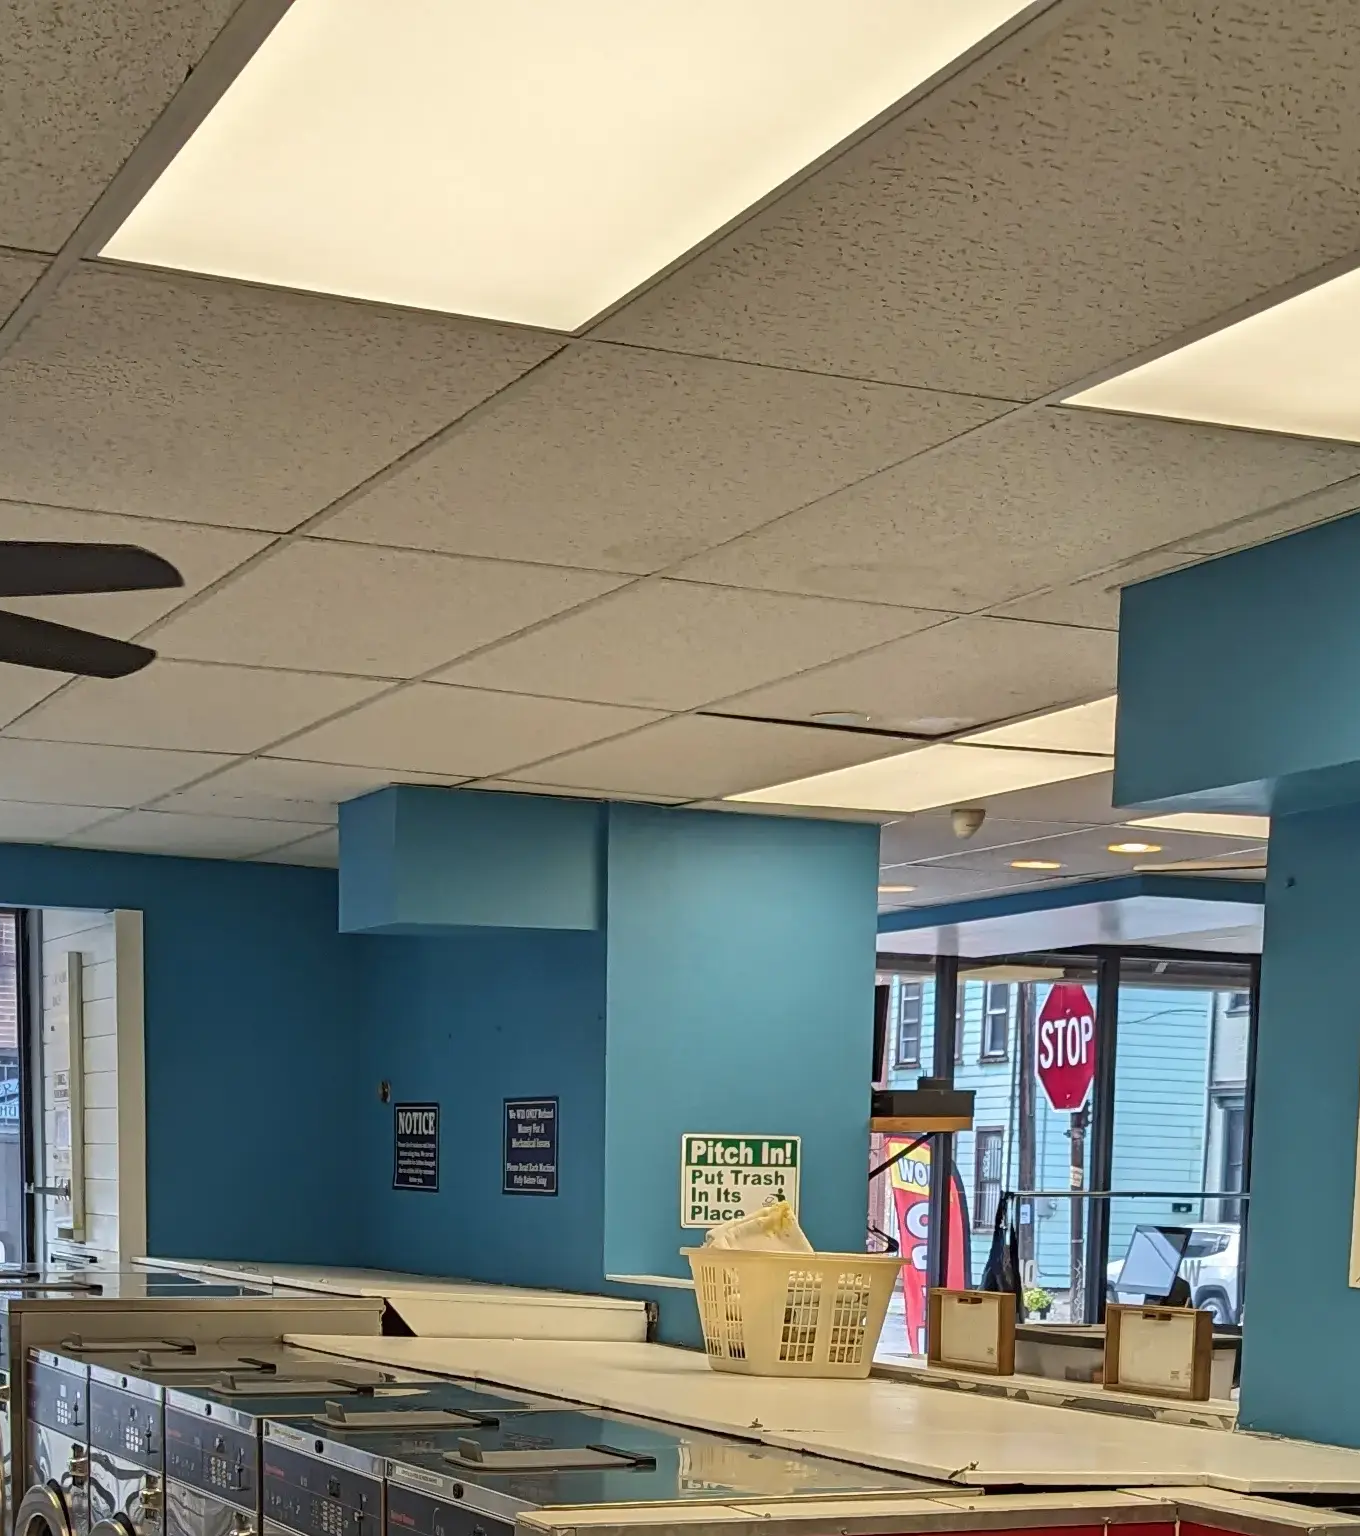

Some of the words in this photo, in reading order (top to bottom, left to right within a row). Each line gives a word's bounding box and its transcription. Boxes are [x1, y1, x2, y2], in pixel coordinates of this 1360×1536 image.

[1040, 1015, 1093, 1069] STOP
[397, 1111, 436, 1135] NOTICE
[691, 1140, 753, 1164] Pitch
[761, 1142, 792, 1165] In!
[691, 1170, 723, 1185] Put
[730, 1170, 785, 1186] Trash
[898, 1157, 930, 1185] WO
[691, 1187, 709, 1202] In
[716, 1187, 742, 1203] Its
[691, 1206, 745, 1221] Place
